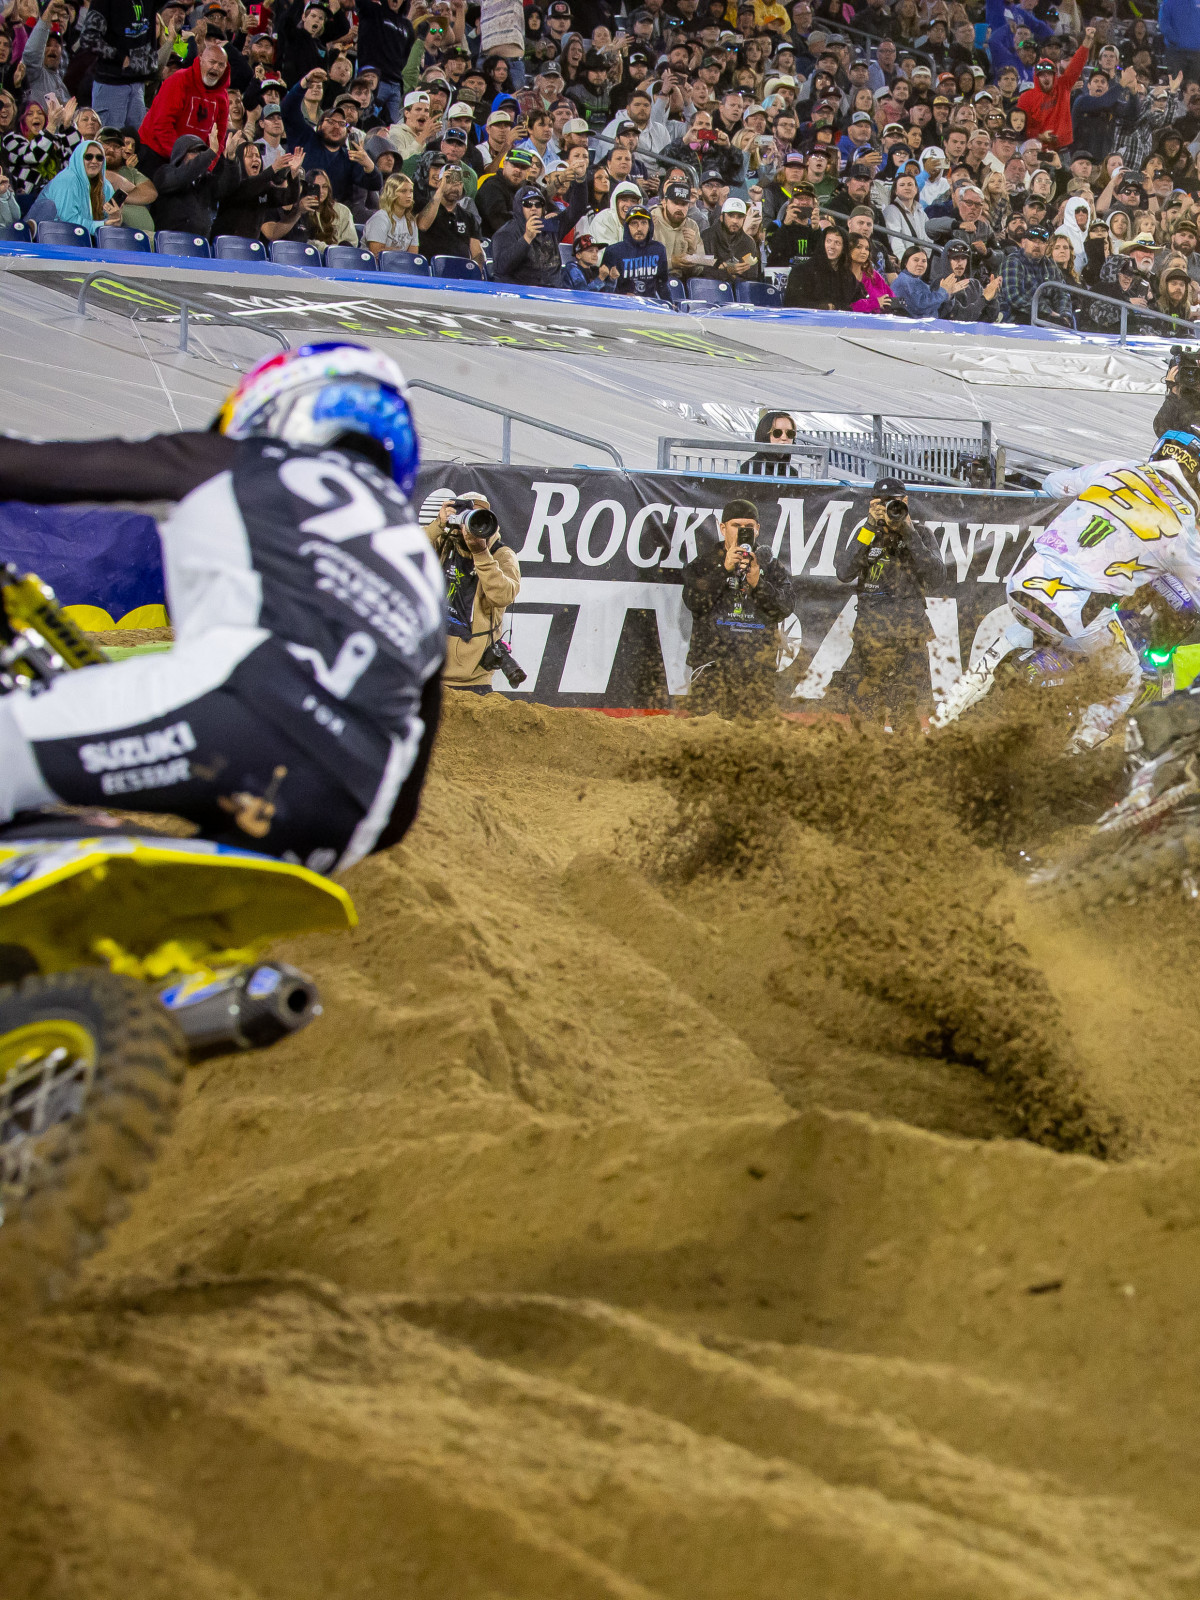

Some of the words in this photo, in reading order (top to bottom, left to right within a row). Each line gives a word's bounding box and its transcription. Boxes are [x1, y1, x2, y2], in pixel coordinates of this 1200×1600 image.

[622, 255, 660, 278] TITANS
[337, 321, 609, 352] ENERGY
[1161, 443, 1198, 473] TOMAC
[1137, 464, 1192, 515] TOMAC
[518, 481, 724, 569] ROCK
[79, 720, 196, 774] SUZUKI
